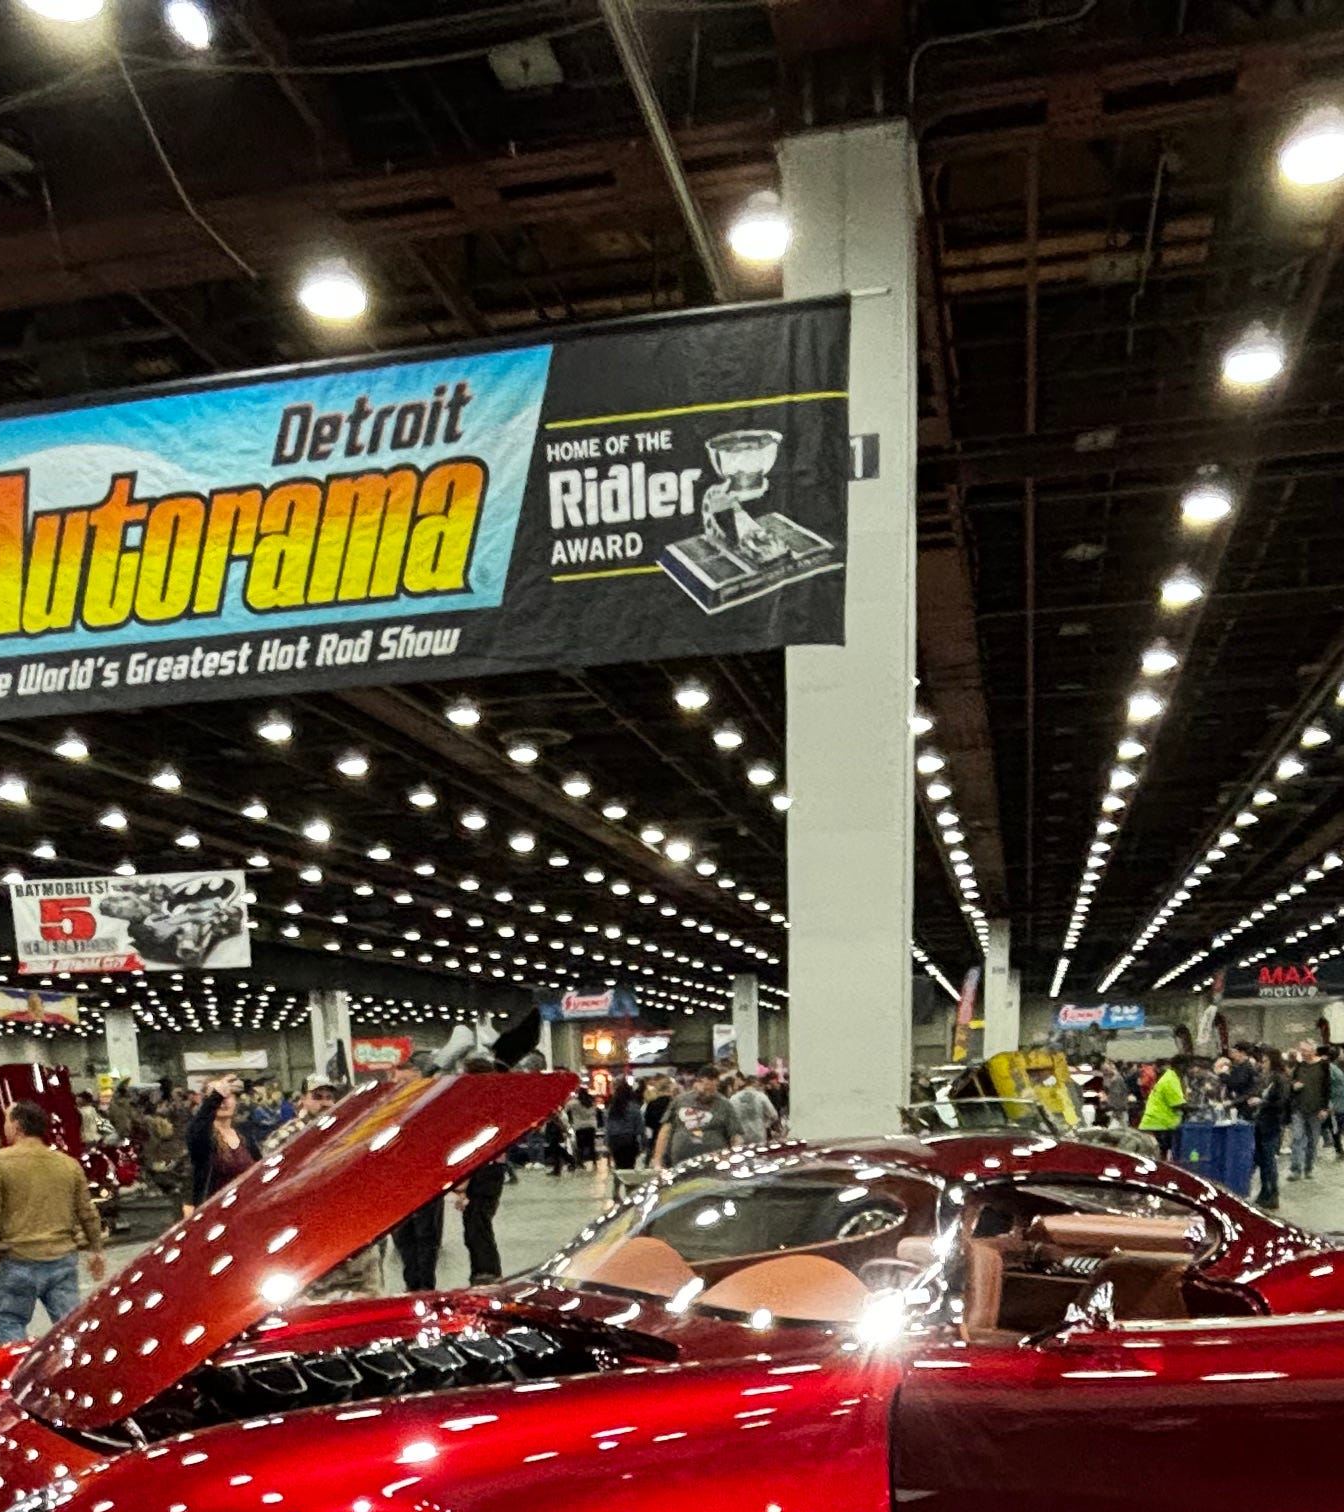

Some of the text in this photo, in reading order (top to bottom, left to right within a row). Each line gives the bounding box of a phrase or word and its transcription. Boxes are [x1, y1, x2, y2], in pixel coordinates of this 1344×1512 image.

[272, 380, 473, 466] Detroit
[546, 430, 673, 463] HOME OF THE
[549, 461, 702, 529] Ridler
[551, 532, 643, 566] AWARD
[17, 656, 120, 696] World's
[126, 641, 253, 685] Greatest
[257, 635, 311, 673] Hot
[316, 628, 374, 667] Rod
[377, 624, 462, 661] Show
[39, 897, 97, 942] 5
[1258, 965, 1318, 985] MAX
